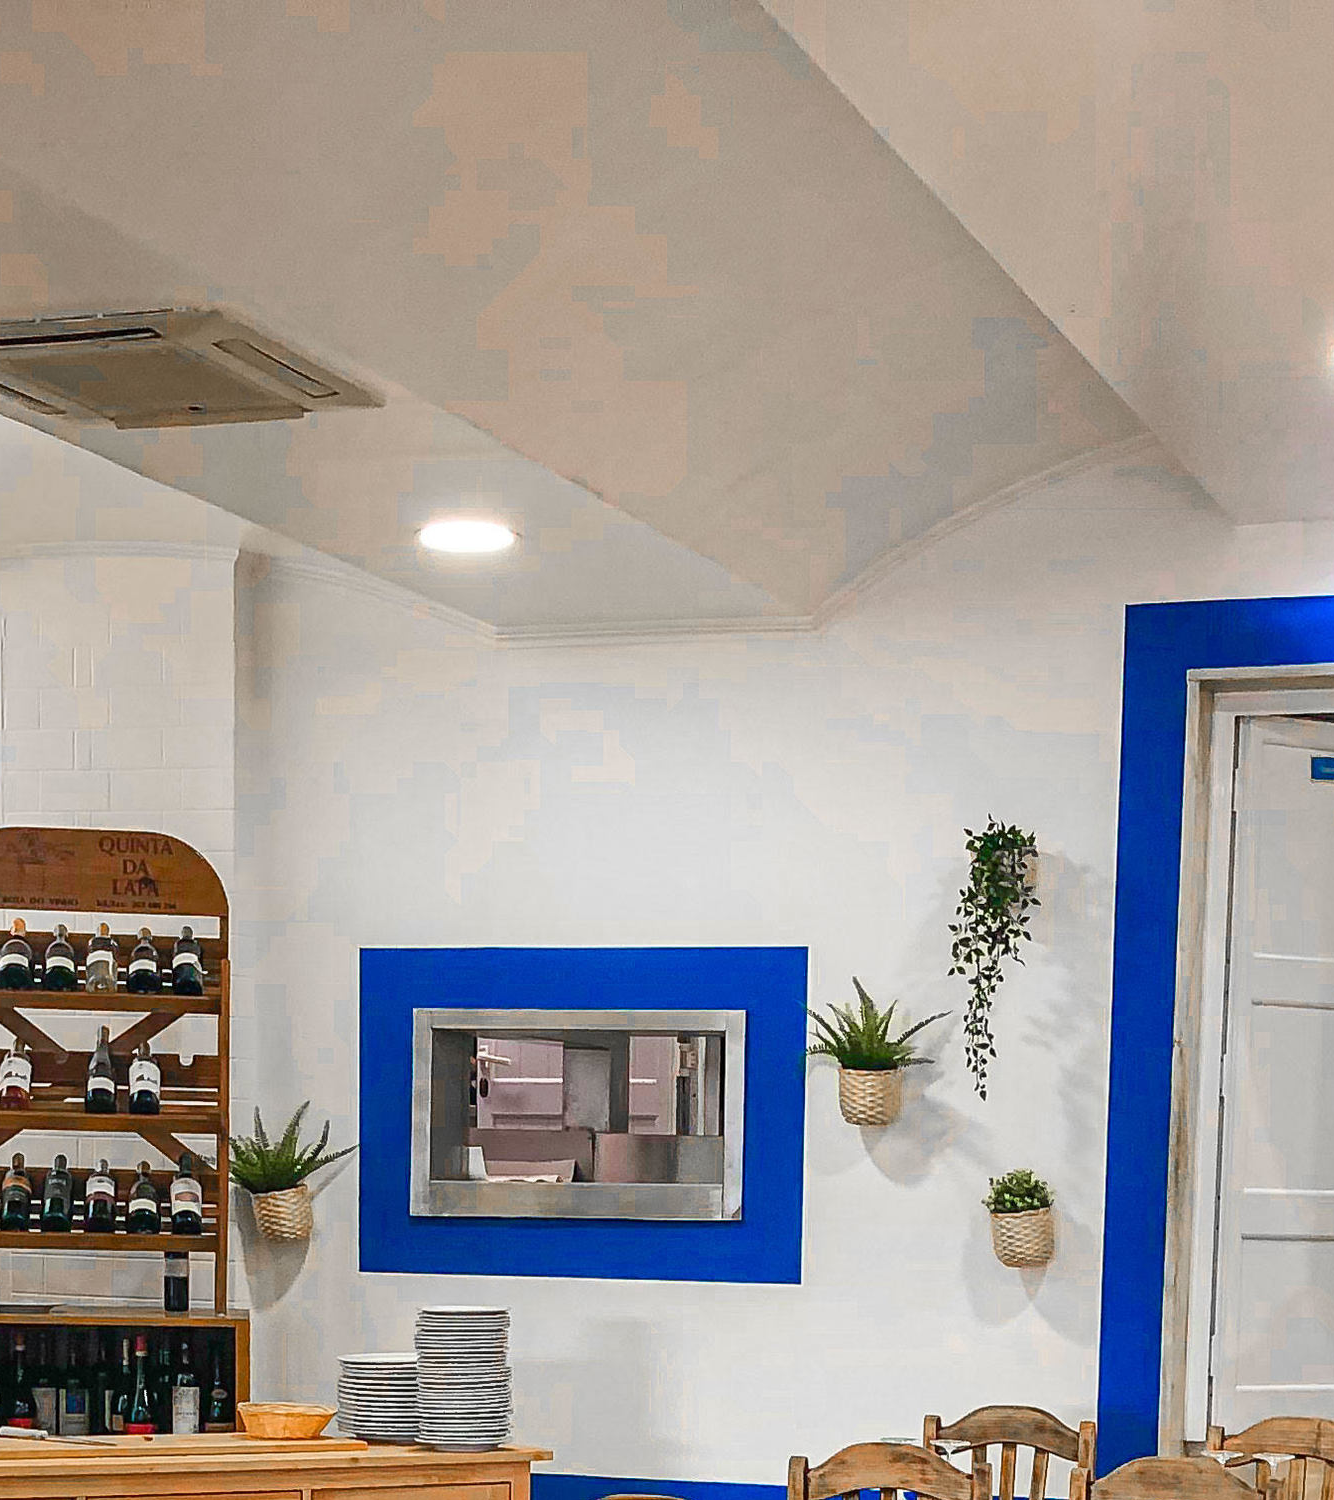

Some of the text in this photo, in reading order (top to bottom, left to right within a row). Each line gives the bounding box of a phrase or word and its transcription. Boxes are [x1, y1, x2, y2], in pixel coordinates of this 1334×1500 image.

[99, 836, 173, 856] QUINTA
[123, 859, 149, 875] DA
[112, 878, 160, 897] LAPA
